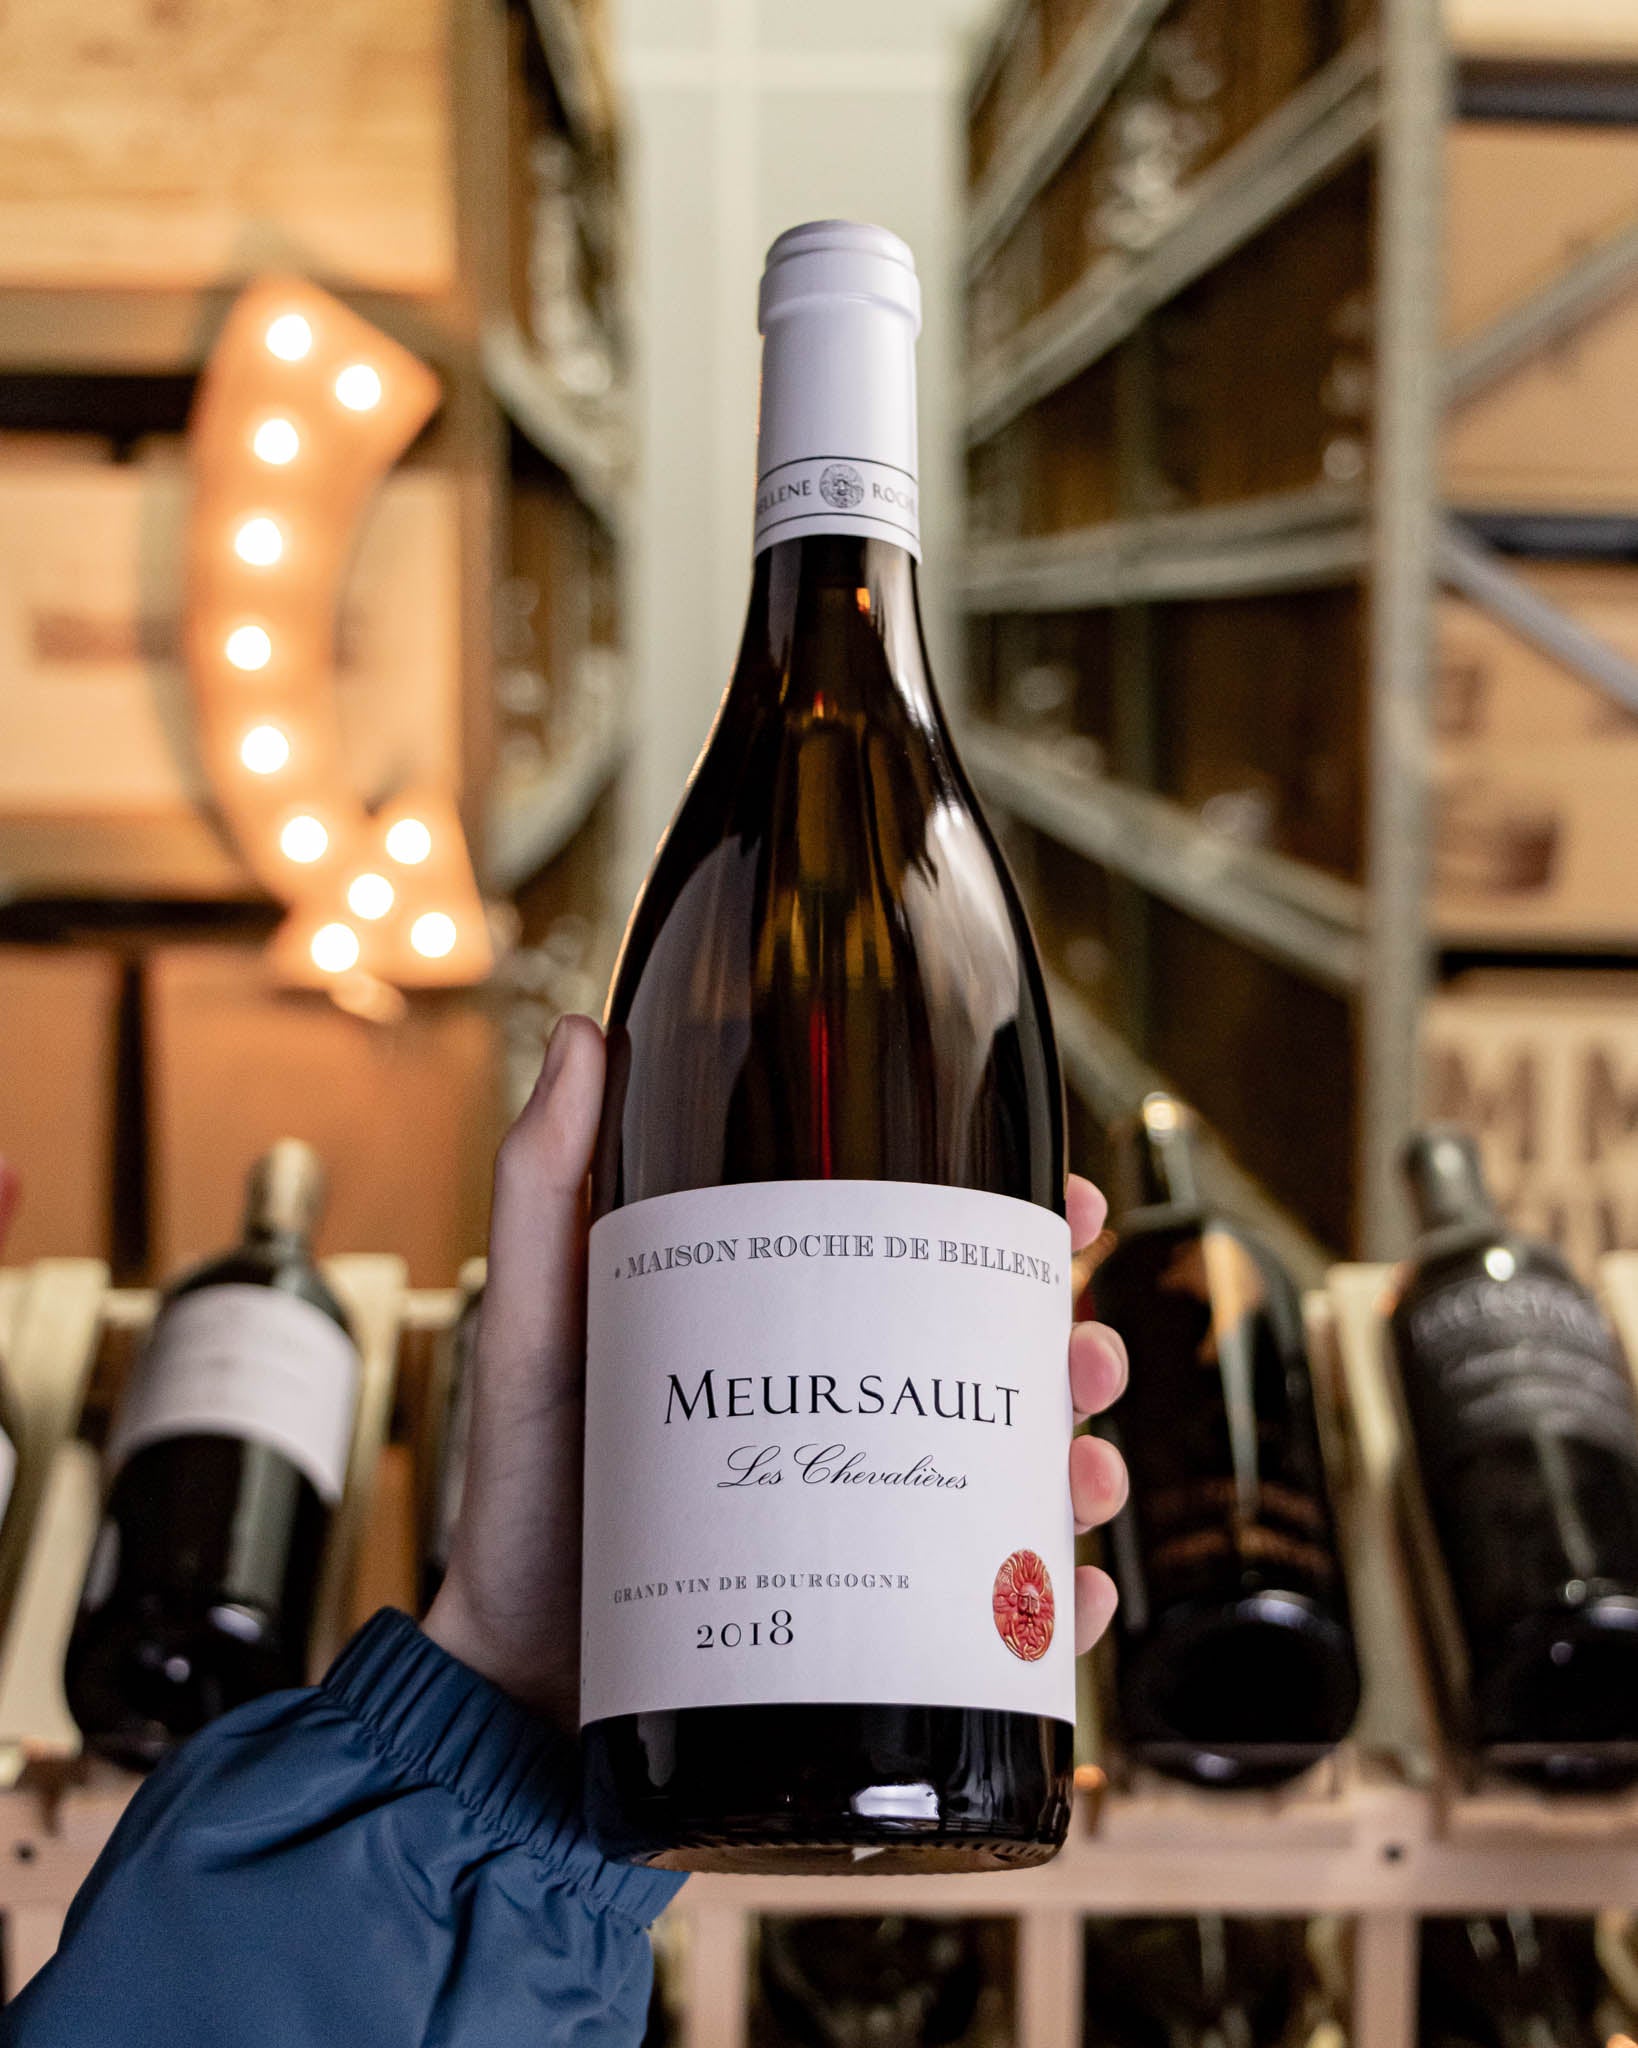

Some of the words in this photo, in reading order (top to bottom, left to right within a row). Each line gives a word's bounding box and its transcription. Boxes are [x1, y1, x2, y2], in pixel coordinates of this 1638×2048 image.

[626, 1238, 740, 1279] MAISON
[747, 1234, 874, 1259] ROCHE
[883, 1235, 929, 1260] DE
[938, 1239, 1051, 1285] BELLENE
[664, 1368, 1021, 1427] MEURSAULT
[716, 1445, 784, 1489] Les
[793, 1443, 968, 1490] Chevalières
[614, 1582, 668, 1604] GRAND
[675, 1578, 710, 1593] VIN
[719, 1575, 747, 1590] DE
[756, 1573, 910, 1589] BOURGOGNE
[696, 1609, 794, 1649] 2018
